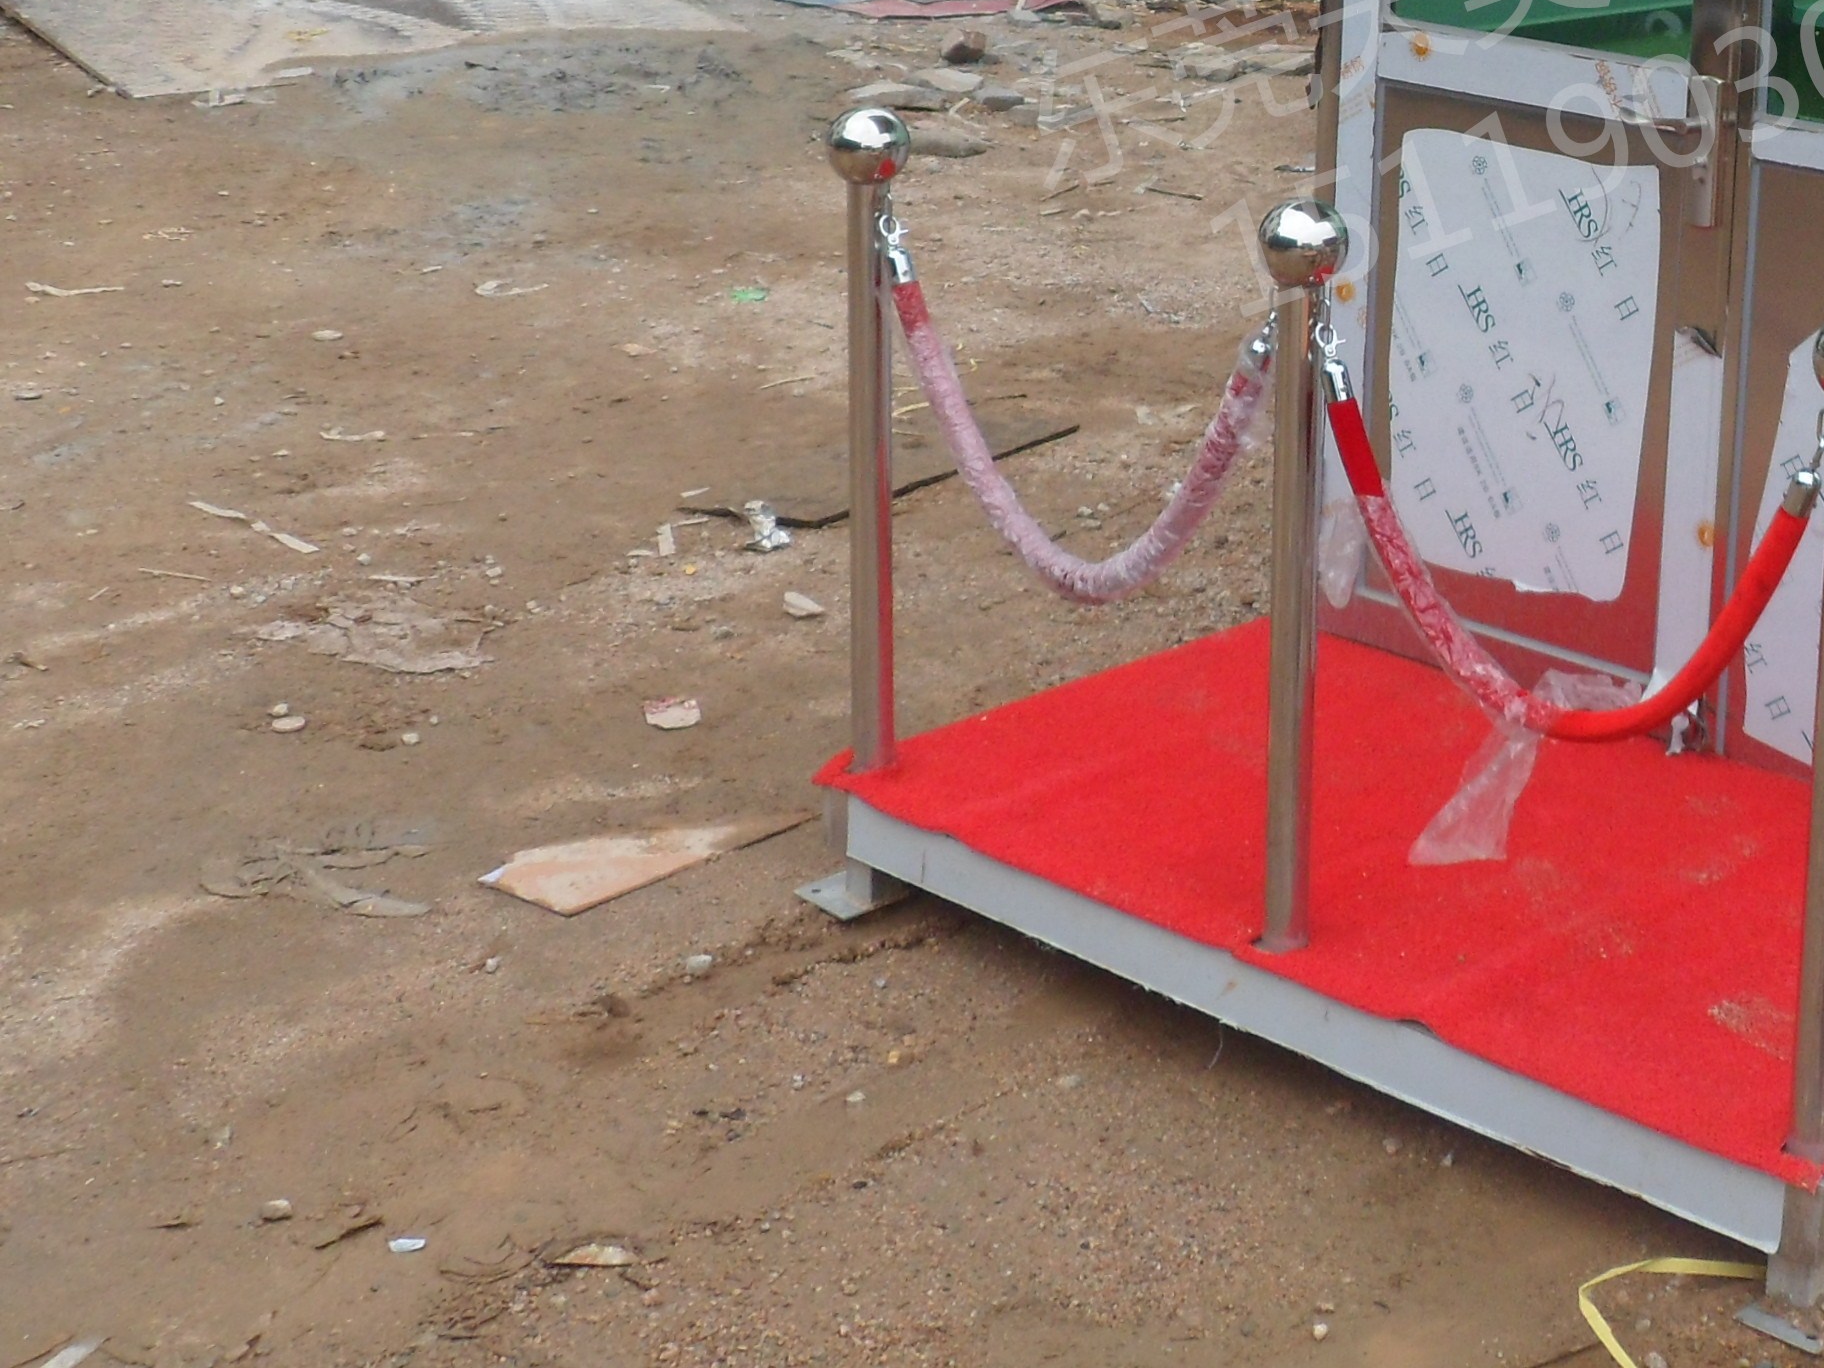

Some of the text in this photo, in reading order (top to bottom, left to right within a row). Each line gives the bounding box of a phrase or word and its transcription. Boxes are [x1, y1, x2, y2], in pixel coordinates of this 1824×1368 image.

[1558, 188, 1599, 238] HRS
[1458, 284, 1496, 333] HRS
[1544, 422, 1583, 472] HRS
[1445, 509, 1483, 559] HRS
